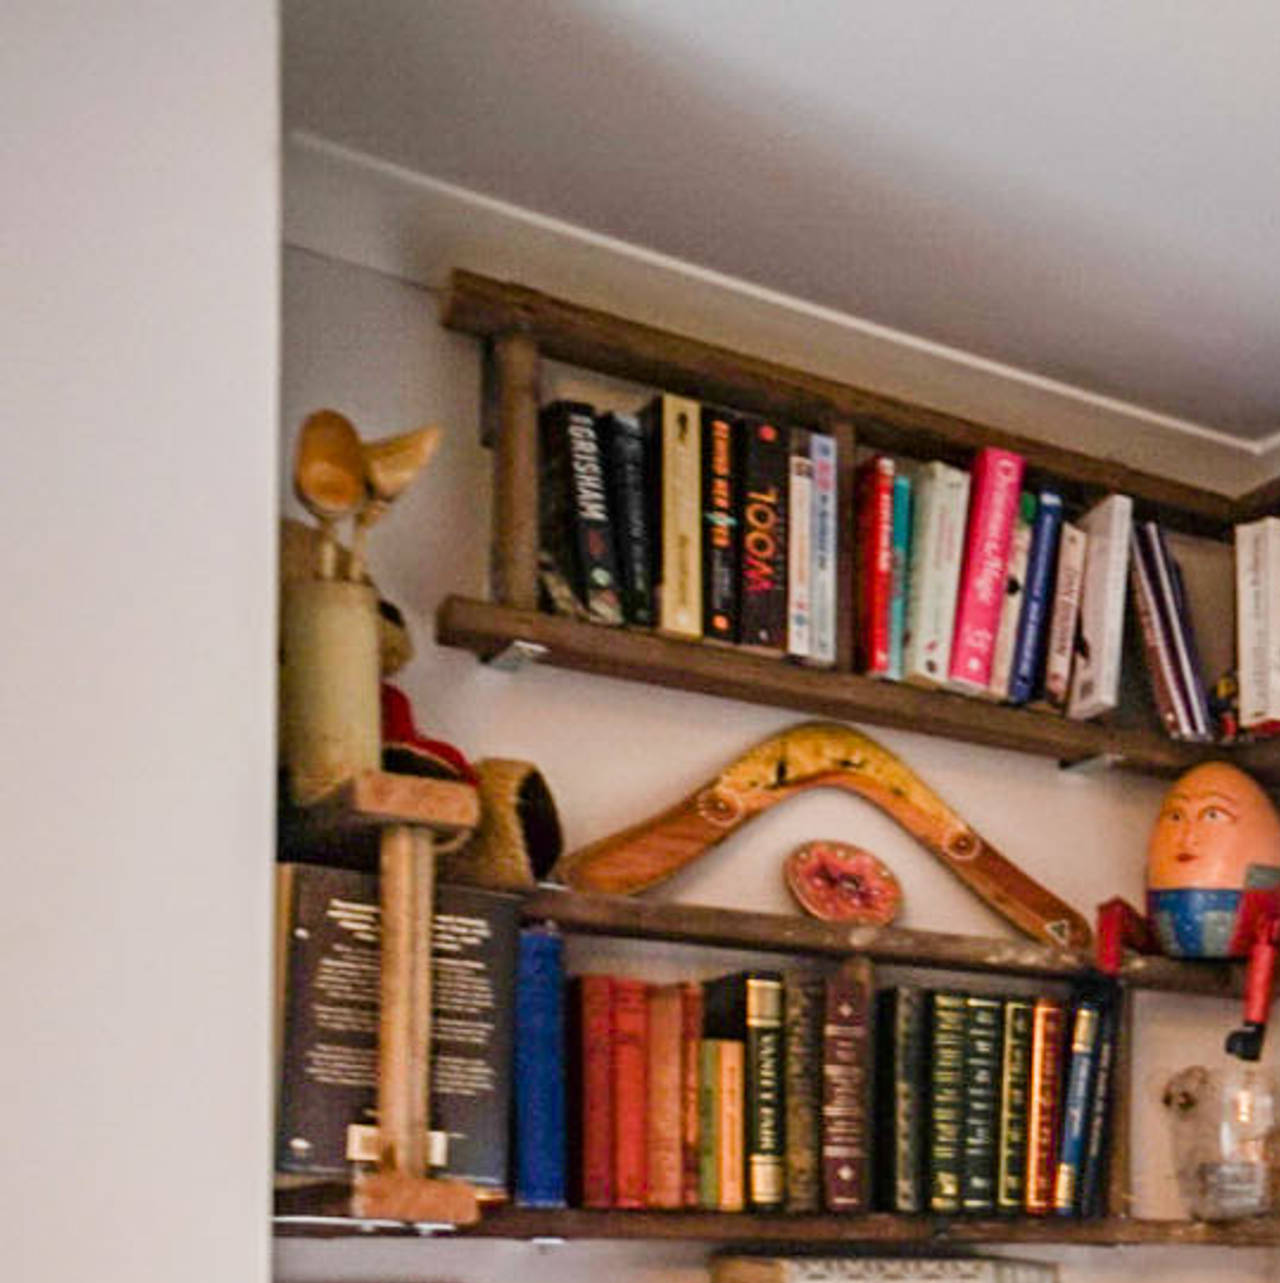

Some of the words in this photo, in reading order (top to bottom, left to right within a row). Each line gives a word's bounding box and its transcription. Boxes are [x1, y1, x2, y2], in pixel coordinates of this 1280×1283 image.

[573, 427, 608, 522] GRISHAM
[743, 486, 779, 593] WOOL
[759, 1033, 777, 1101] VANITY
[759, 1106, 776, 1150] FAIR
